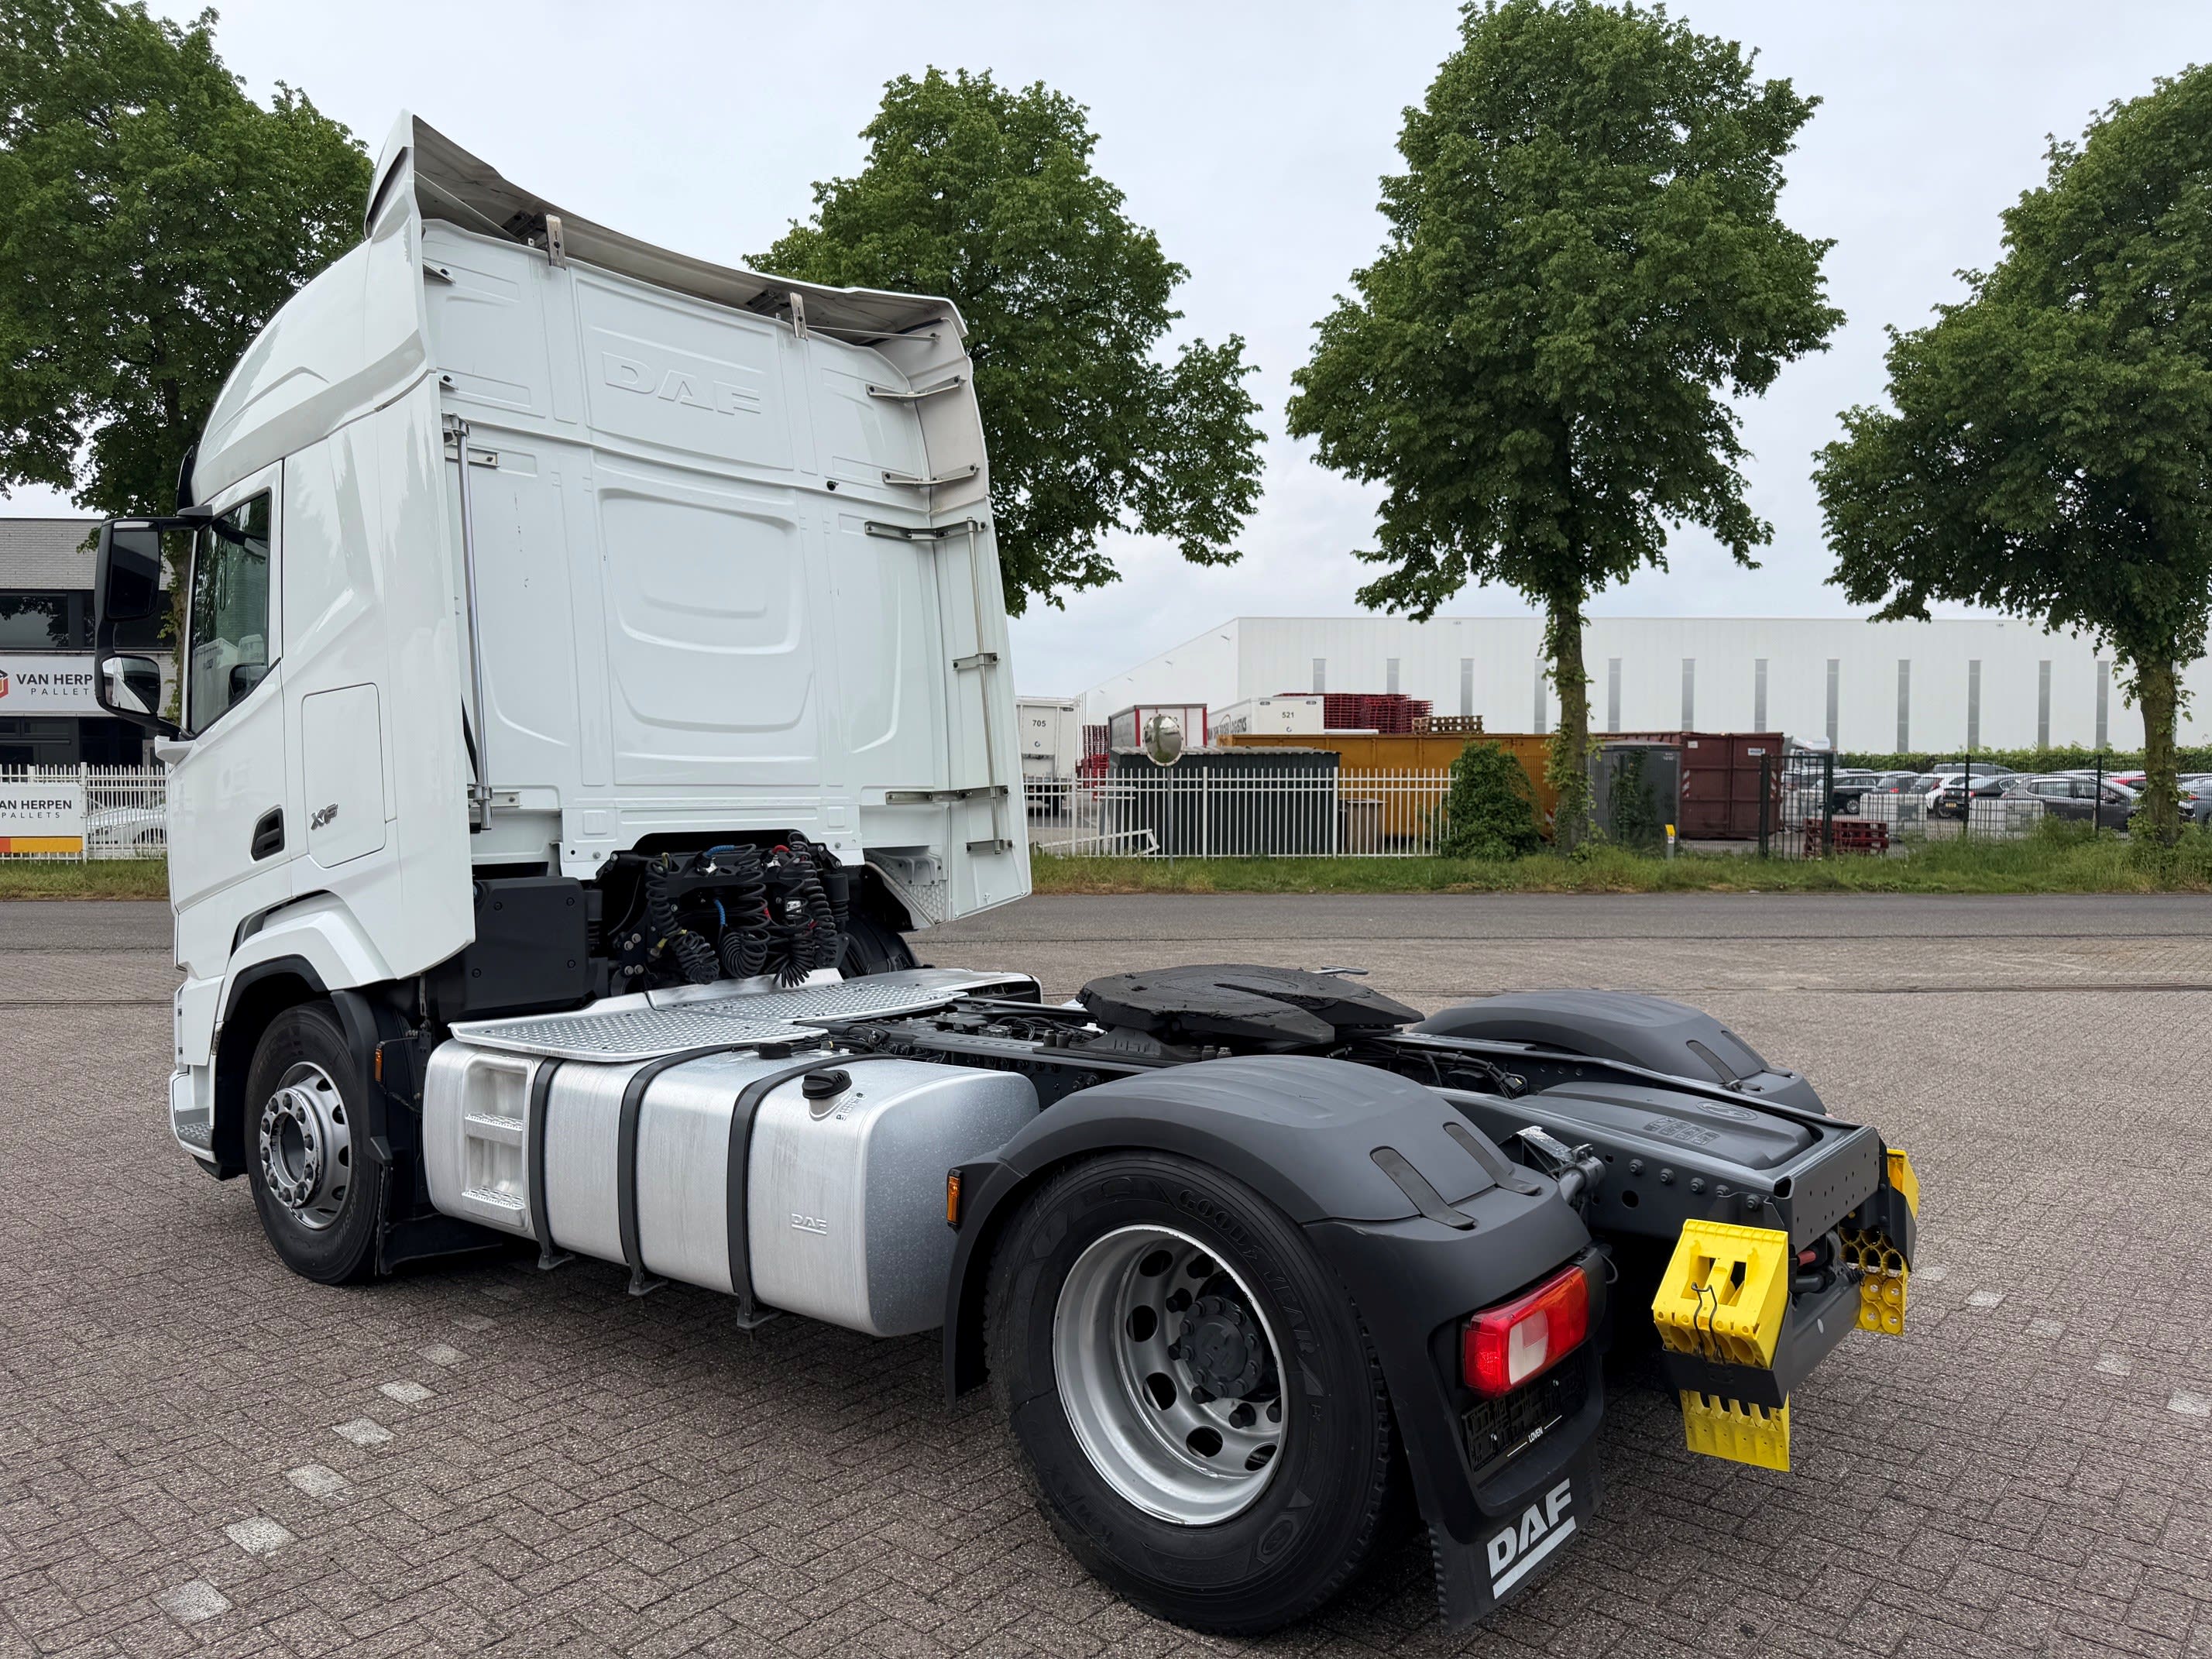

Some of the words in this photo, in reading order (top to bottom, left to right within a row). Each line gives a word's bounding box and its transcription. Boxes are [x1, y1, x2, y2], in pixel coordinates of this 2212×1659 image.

[602, 352, 761, 416] DAF
[16, 674, 49, 685] VAN
[53, 674, 94, 685] HERP
[0, 800, 17, 809] AN
[21, 800, 72, 809] HERPEN
[791, 1213, 827, 1230] DAF
[1487, 1478, 1572, 1571] DAF
